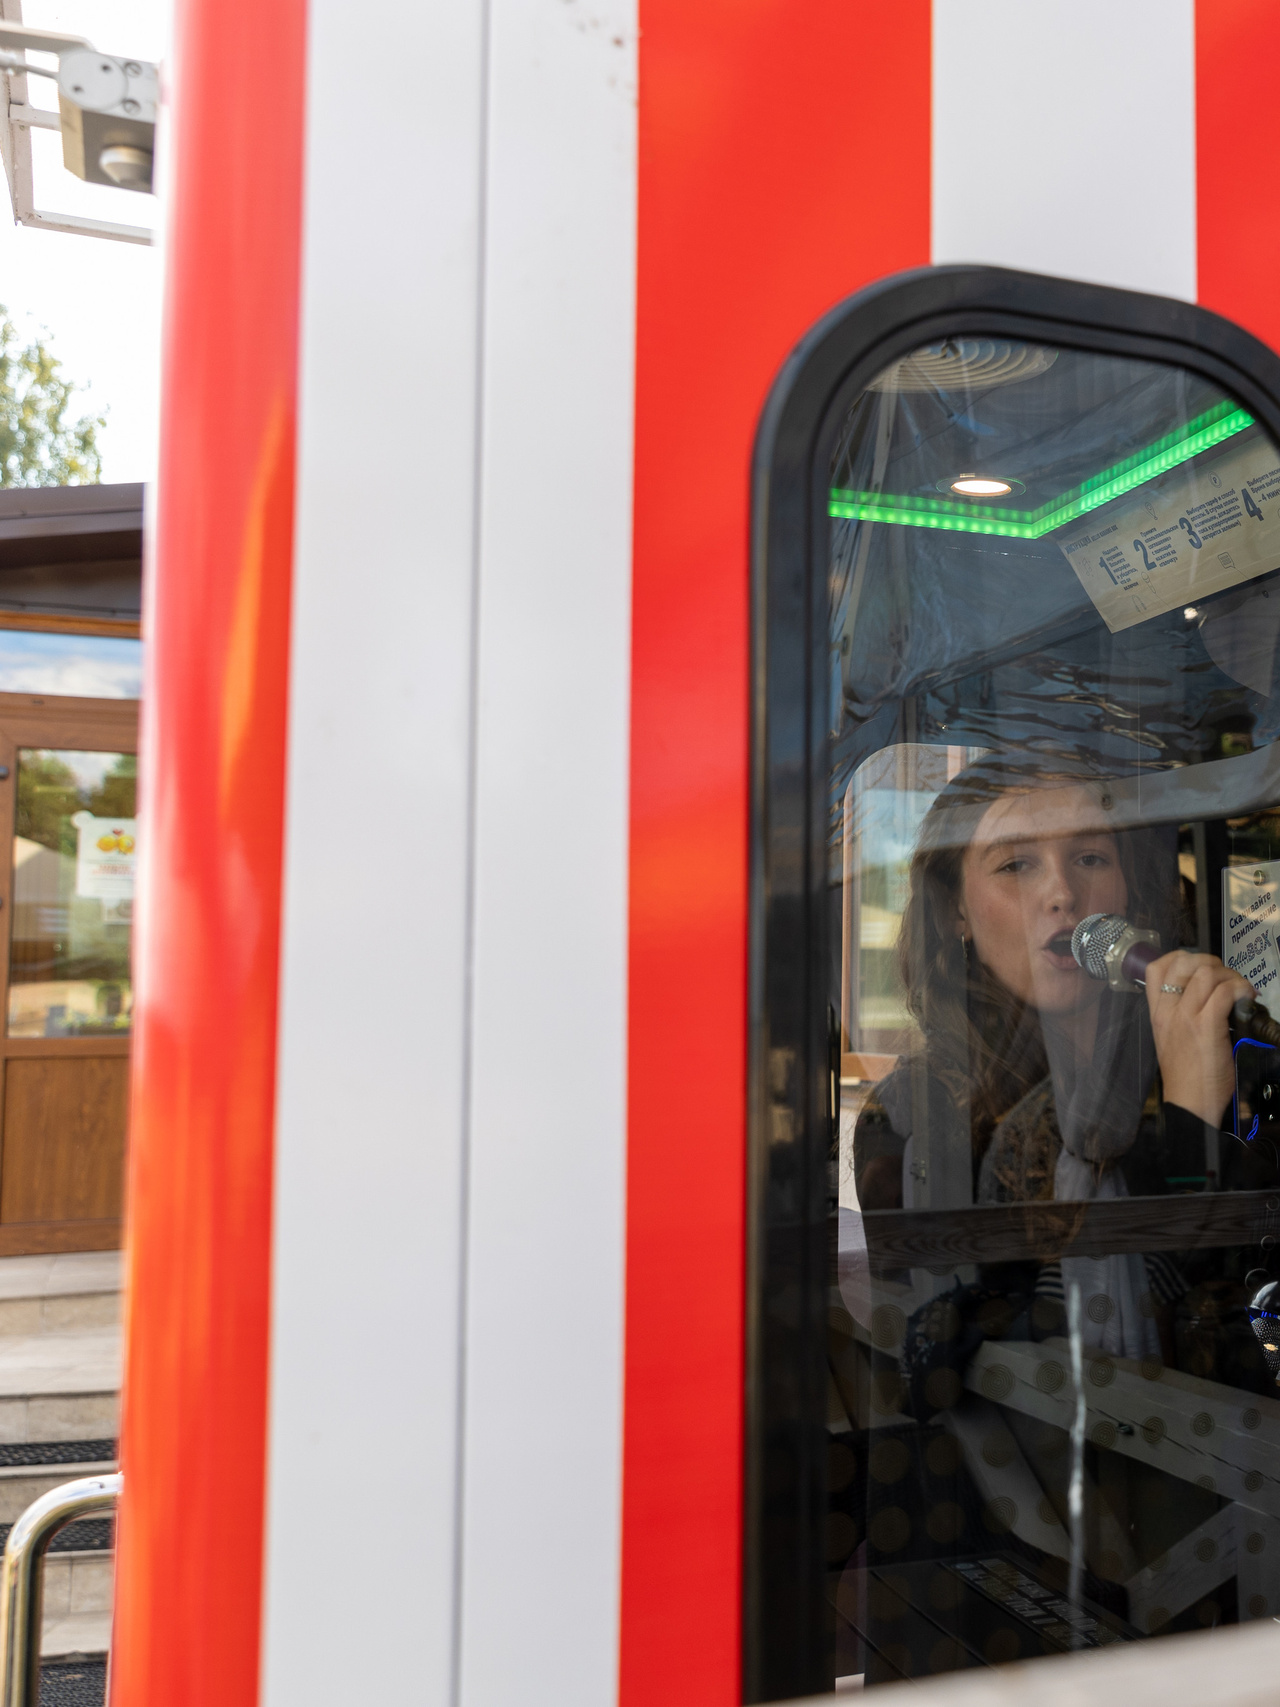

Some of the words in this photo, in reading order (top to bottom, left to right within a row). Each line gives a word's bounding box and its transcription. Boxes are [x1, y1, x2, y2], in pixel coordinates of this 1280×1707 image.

[1241, 488, 1264, 522] 4
[1179, 517, 1202, 549] 3
[1098, 556, 1118, 586] 1
[1133, 539, 1157, 571] 2
[1229, 892, 1271, 929] Скачивайте
[1231, 904, 1276, 944] приложение
[1249, 957, 1267, 979] свой
